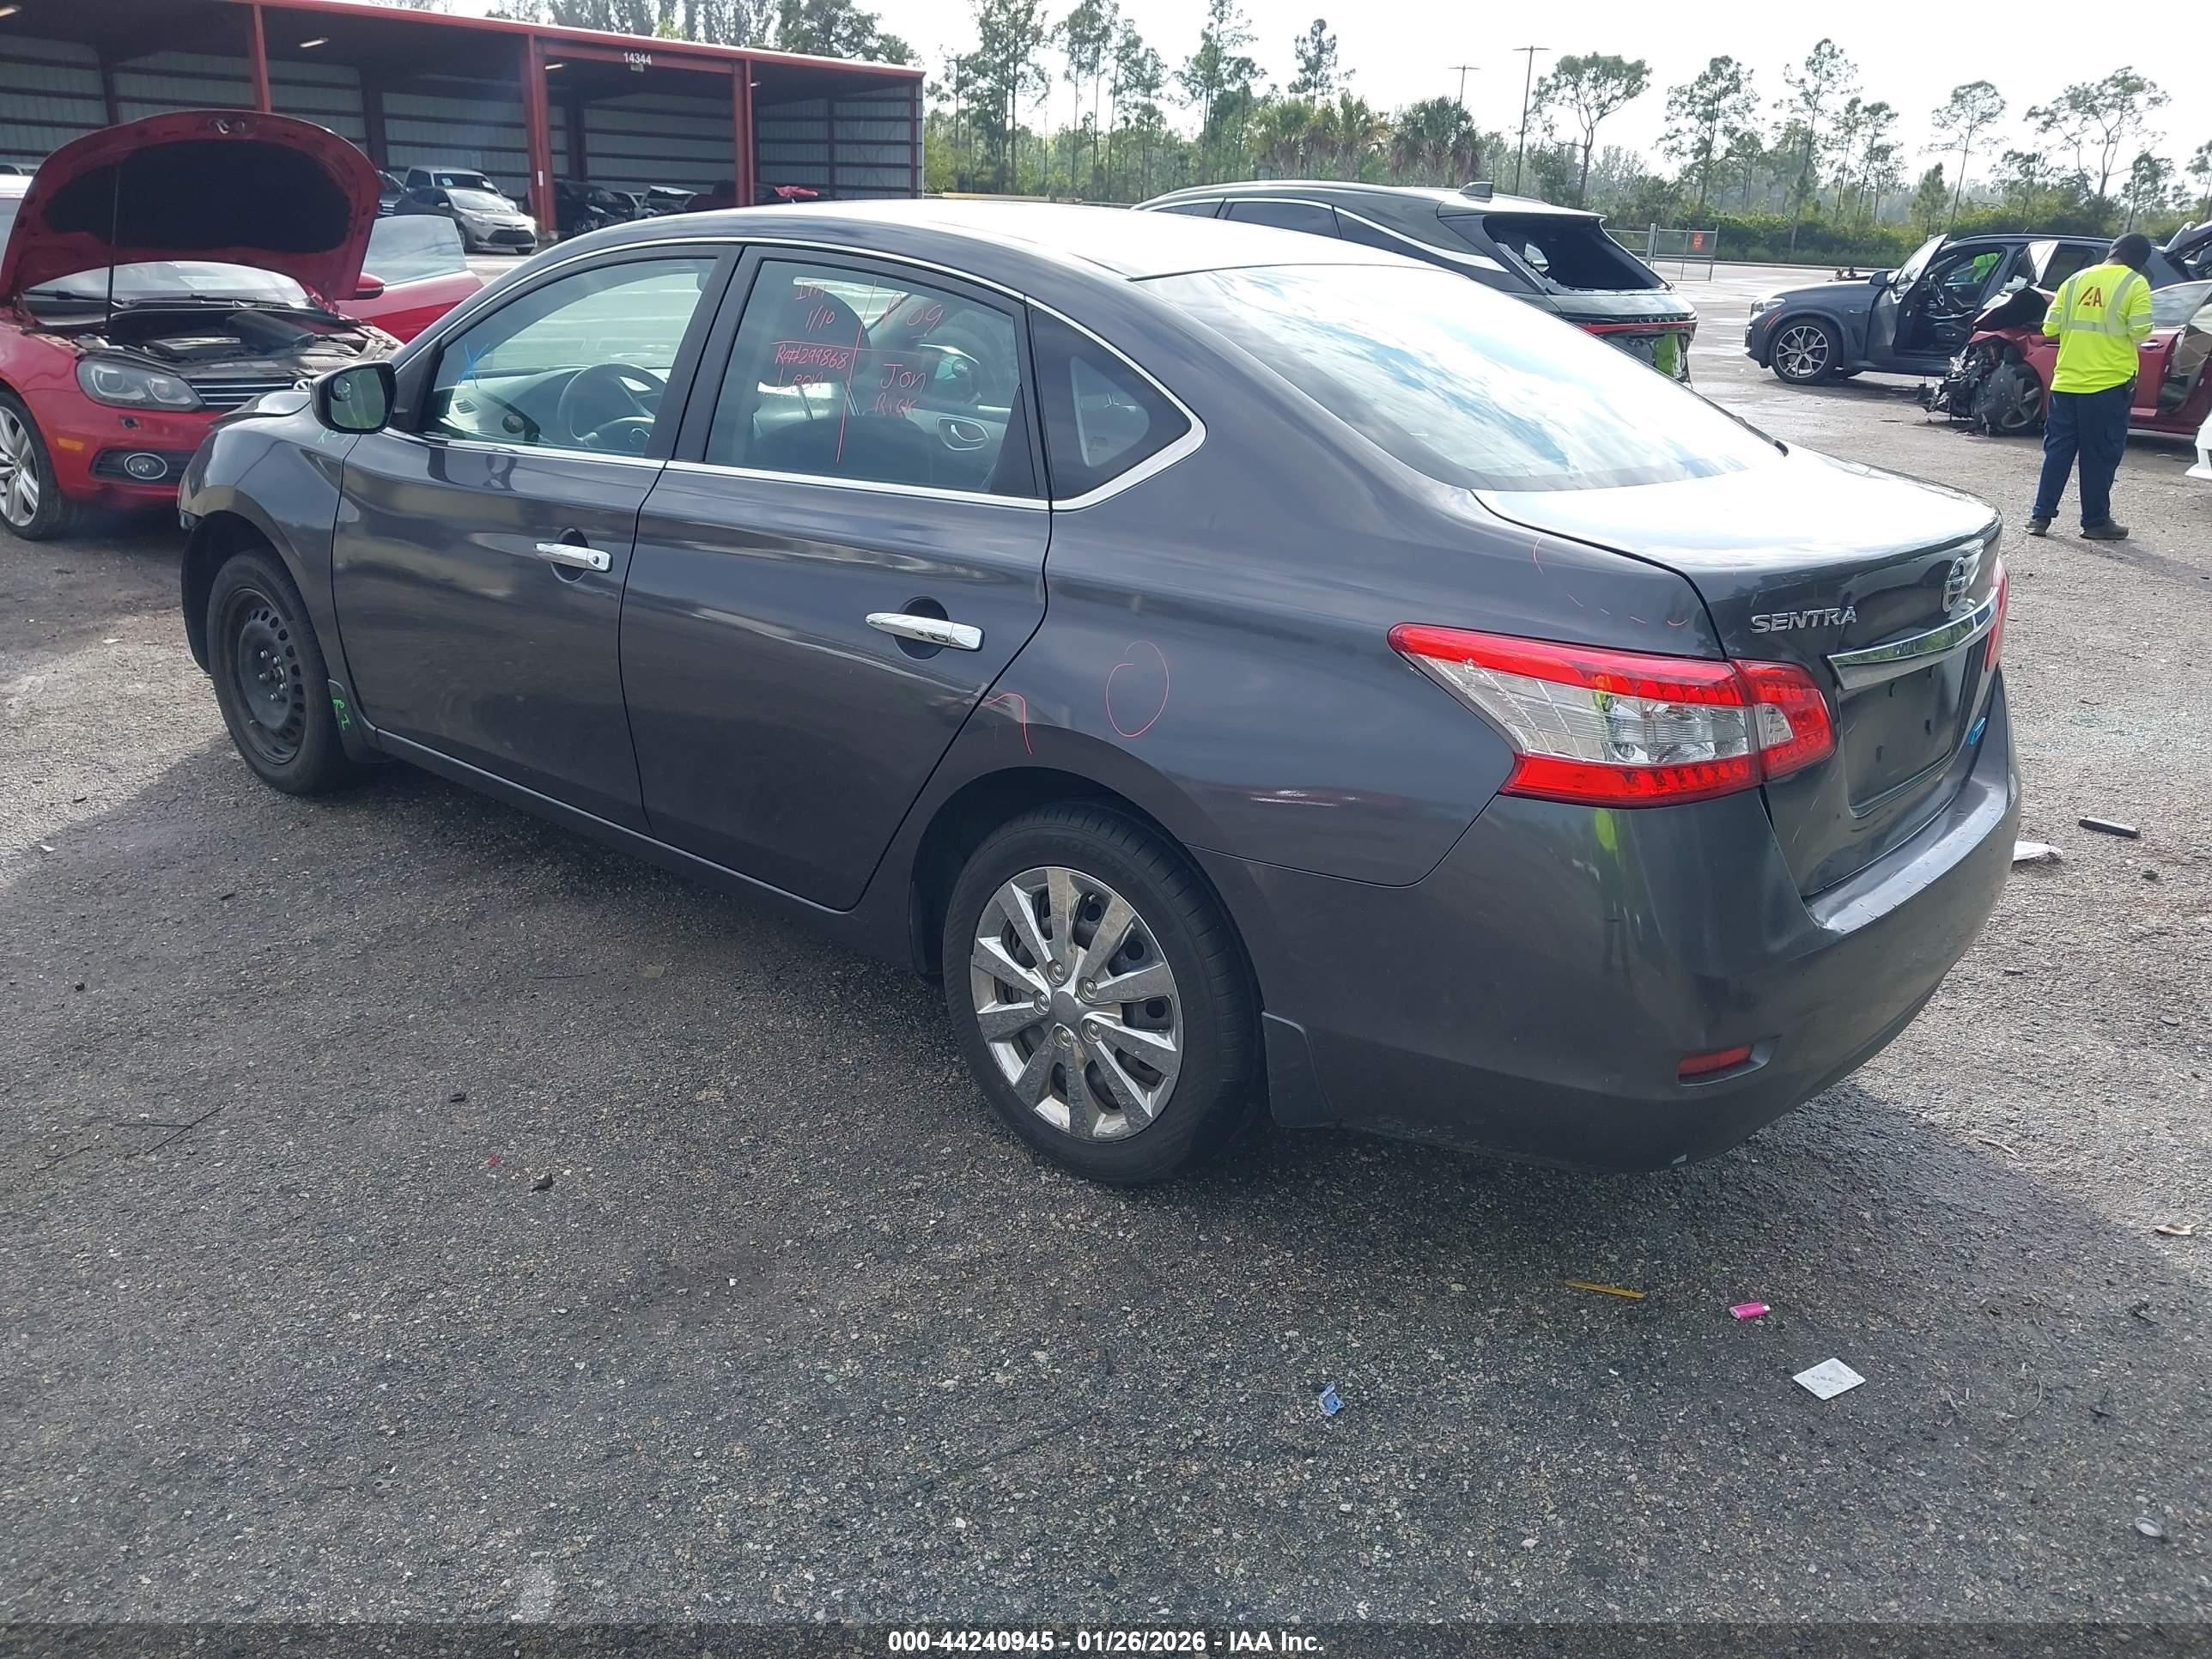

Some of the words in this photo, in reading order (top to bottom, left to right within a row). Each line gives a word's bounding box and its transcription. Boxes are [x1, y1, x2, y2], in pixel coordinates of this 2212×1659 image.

[623, 52, 652, 65] 14344
[805, 304, 836, 333] 1/10
[1750, 606, 1857, 634] SENTRA
